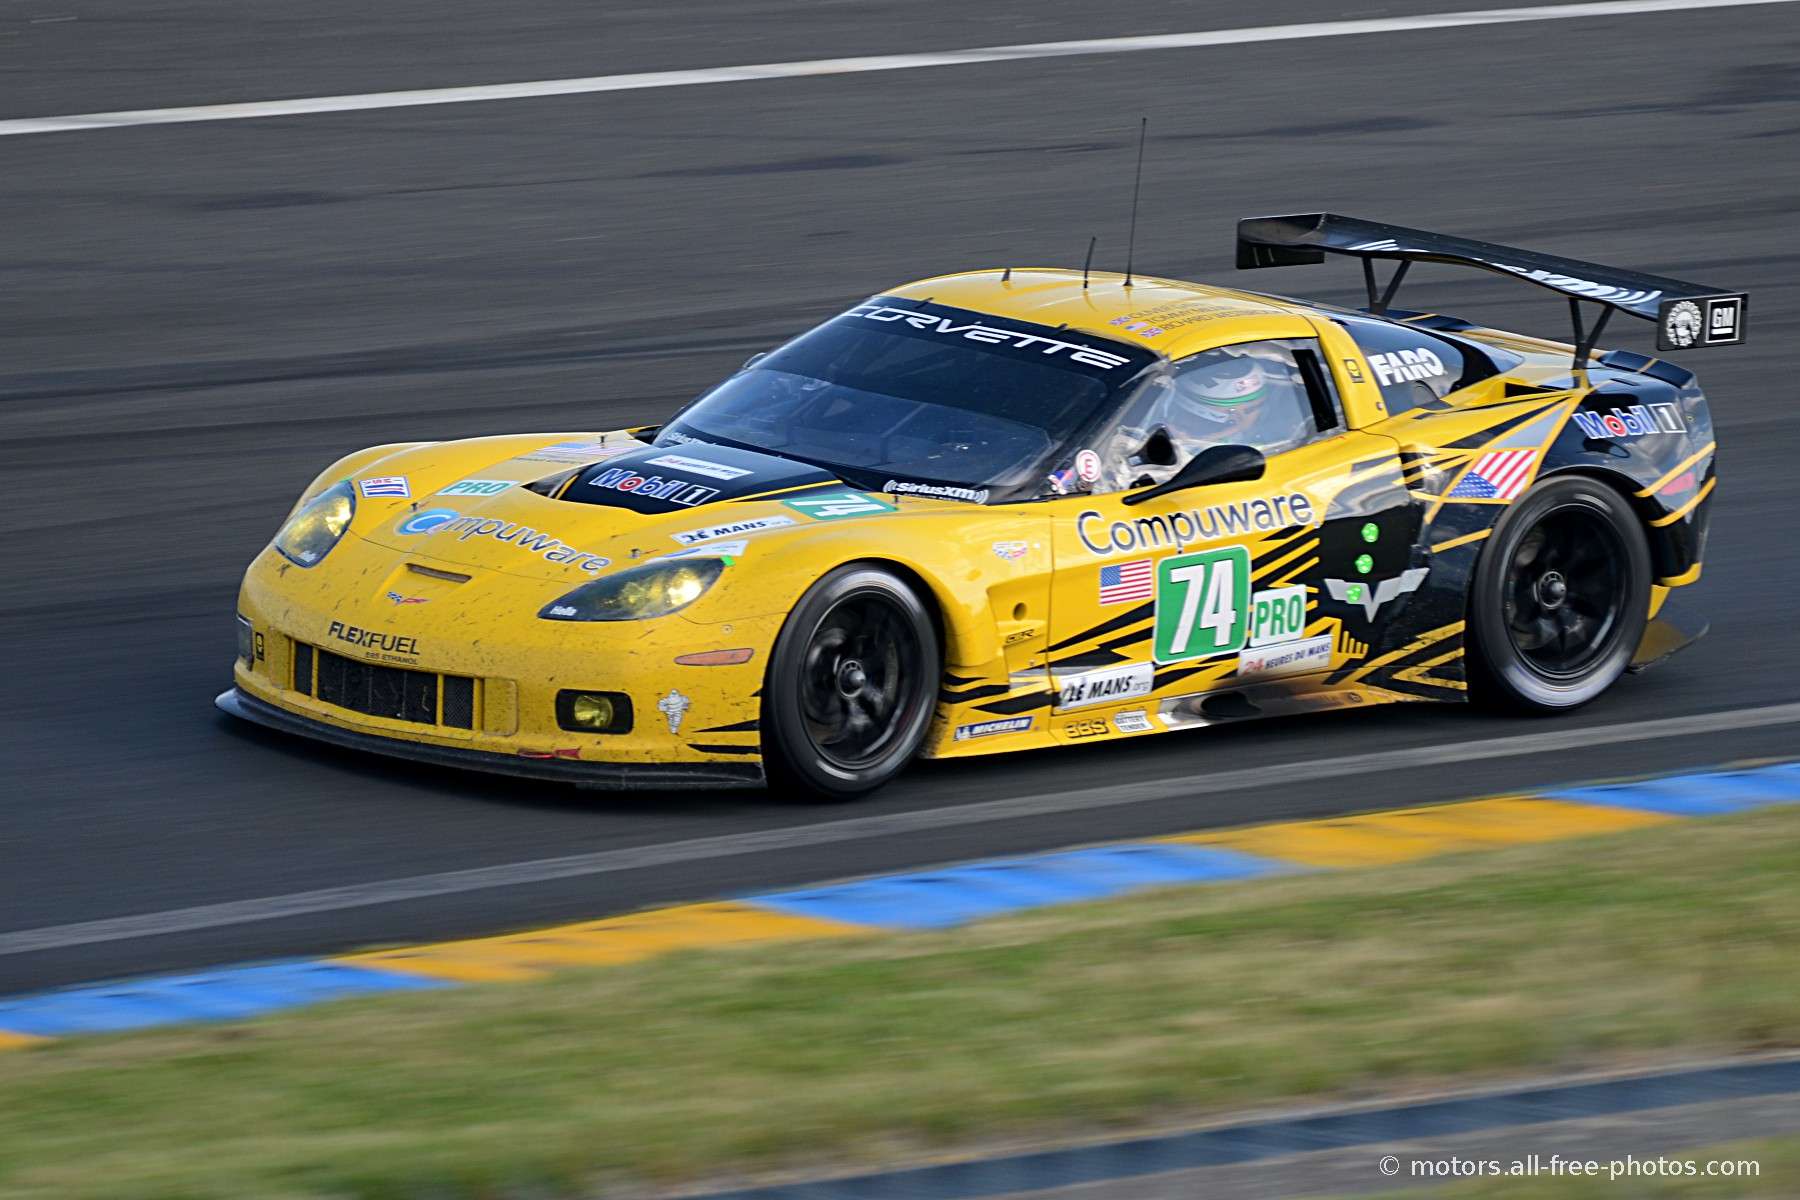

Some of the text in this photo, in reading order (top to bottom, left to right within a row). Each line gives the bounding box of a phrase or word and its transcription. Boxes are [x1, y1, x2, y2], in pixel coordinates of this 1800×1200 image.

[1712, 306, 1736, 328] GM
[848, 305, 1131, 370] CORVETTE
[1367, 347, 1444, 387] FARO
[1571, 404, 1681, 439] Mobil 1
[441, 480, 509, 495] PRO
[588, 468, 688, 500] Mobil
[789, 494, 886, 517] 74
[714, 520, 770, 537] MANS
[1077, 492, 1315, 554] Compuware
[1169, 559, 1236, 655] 74
[1253, 594, 1302, 639] PRO
[328, 620, 421, 655] FLEXFUEL
[1087, 674, 1134, 698] MANS
[970, 718, 1031, 736] MICHELIN
